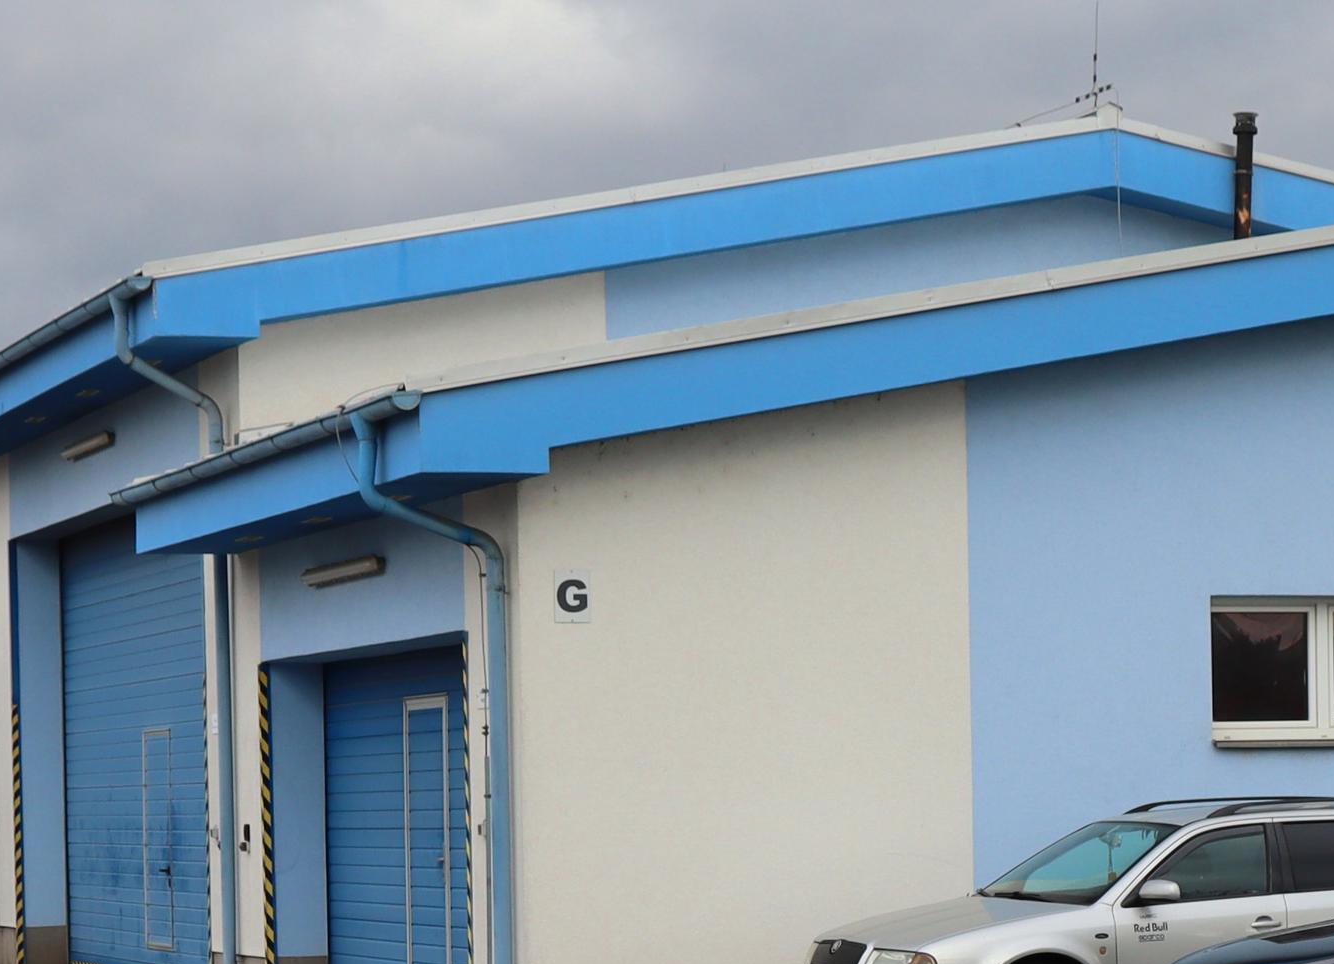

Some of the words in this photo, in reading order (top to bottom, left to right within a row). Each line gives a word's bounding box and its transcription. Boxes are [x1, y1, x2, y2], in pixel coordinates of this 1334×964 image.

[557, 579, 588, 612] G
[1134, 923, 1150, 932] Red
[1152, 922, 1168, 931] Bull
